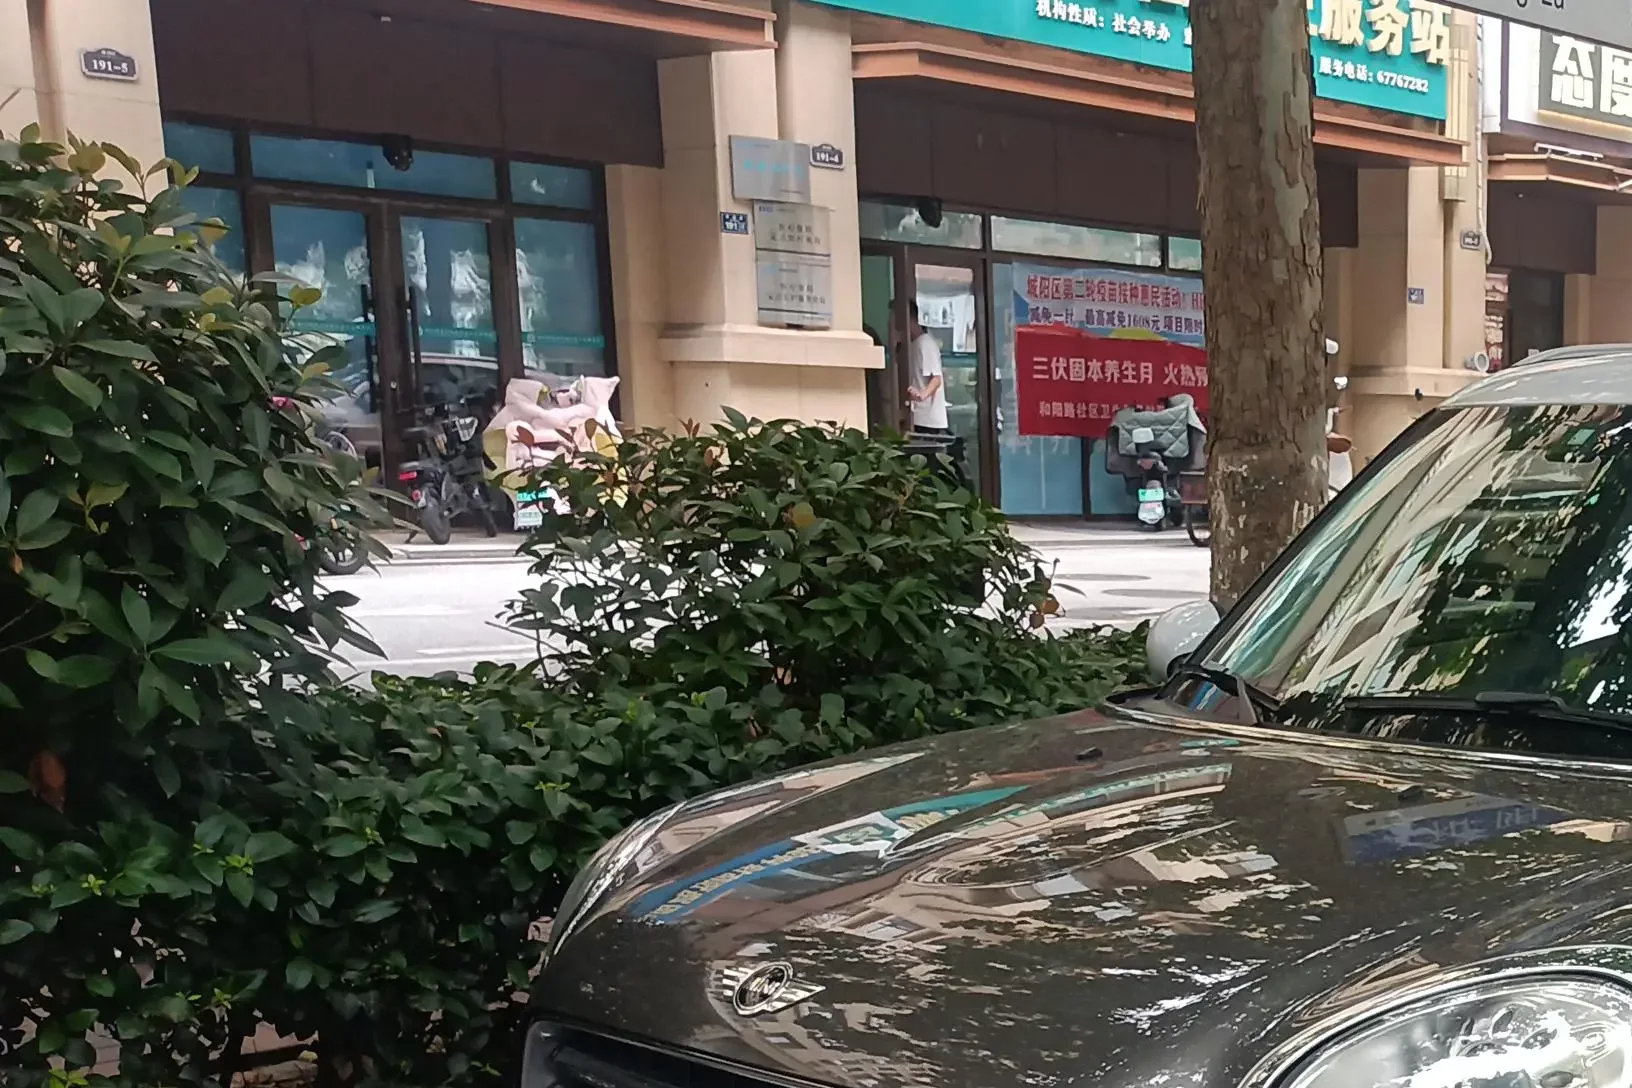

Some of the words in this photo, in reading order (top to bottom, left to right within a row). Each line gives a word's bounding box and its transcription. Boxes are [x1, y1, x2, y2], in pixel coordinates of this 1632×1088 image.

[1308, 0, 1451, 65] 服务站
[93, 60, 129, 73] 191-5
[1032, 356, 1154, 385] 三伏固本养生月
